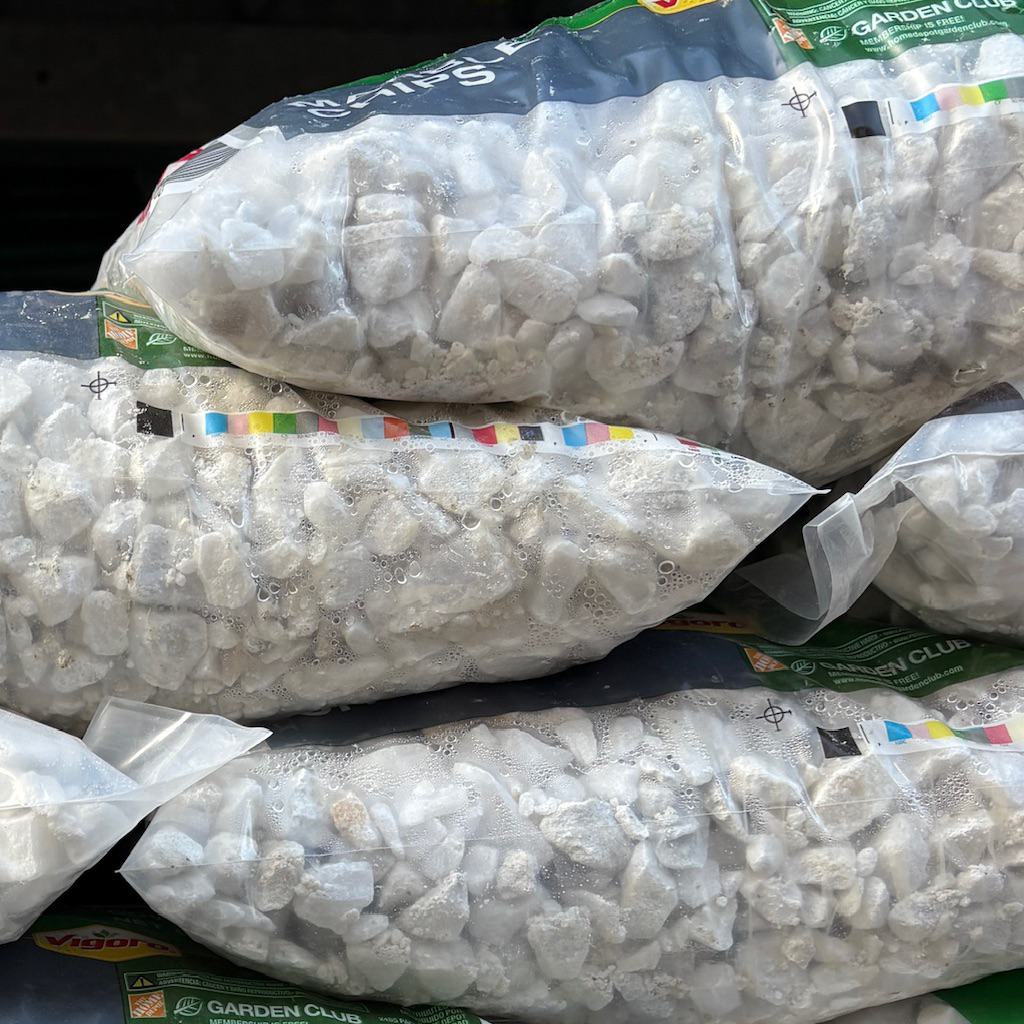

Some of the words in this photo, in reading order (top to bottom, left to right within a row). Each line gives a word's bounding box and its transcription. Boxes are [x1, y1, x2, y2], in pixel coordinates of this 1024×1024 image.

[851, 2, 953, 36] GARDEN
[859, 24, 922, 47] MEMBERSHIP
[924, 21, 935, 29] IS
[936, 15, 965, 27] FREE!
[908, 638, 972, 664] CLUB
[893, 672, 920, 686] FREE!
[46, 934, 168, 949] Vigoro
[132, 992, 164, 1018] HOME
[207, 1000, 301, 1018] GARDEN
[303, 1003, 364, 1024] CLUB
[441, 1013, 466, 1024] DEPOT
